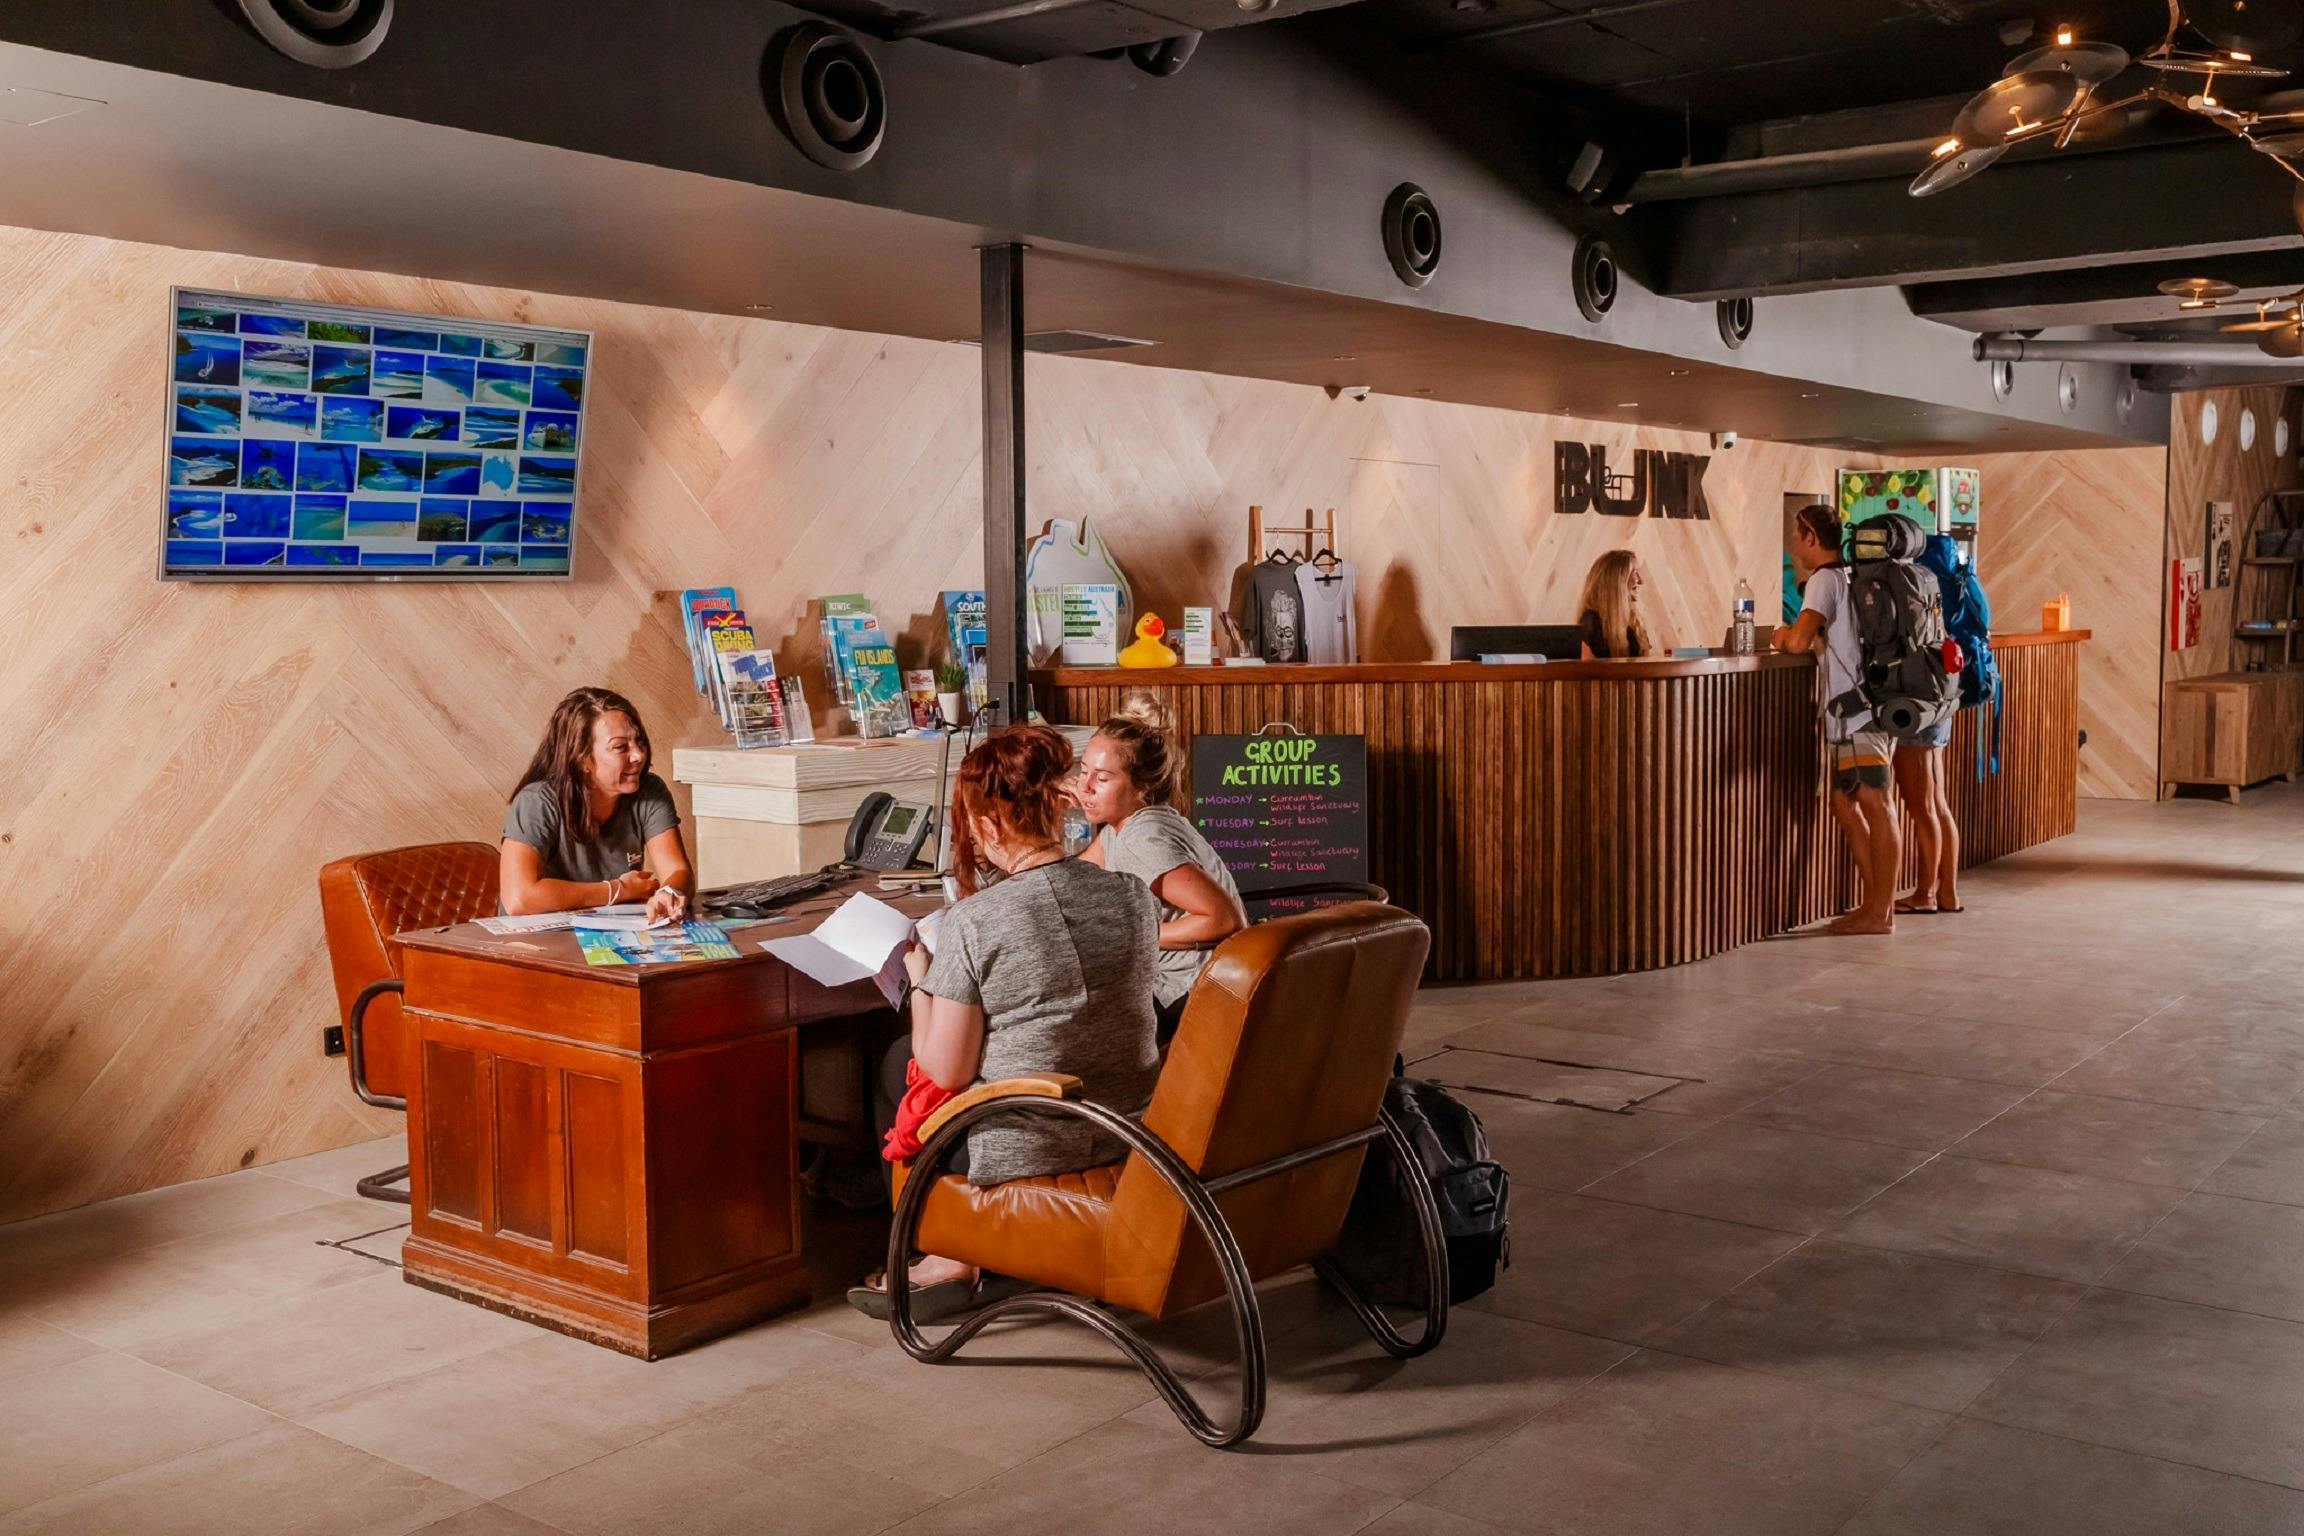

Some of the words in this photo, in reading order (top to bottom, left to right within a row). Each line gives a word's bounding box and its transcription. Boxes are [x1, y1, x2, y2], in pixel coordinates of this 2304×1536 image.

[1554, 440, 1711, 520] BUNK
[711, 630, 753, 641] SCUBA
[1245, 739, 1317, 763] GROUP
[1222, 764, 1341, 786] ACTIVITIES
[1205, 795, 1253, 805] MONDAY
[1311, 801, 1360, 814] Sanctuary
[1206, 818, 1255, 828] TUESDAY
[1270, 817, 1293, 827] Surf
[1270, 860, 1293, 871] Surf
[1296, 862, 1326, 871] Lesson
